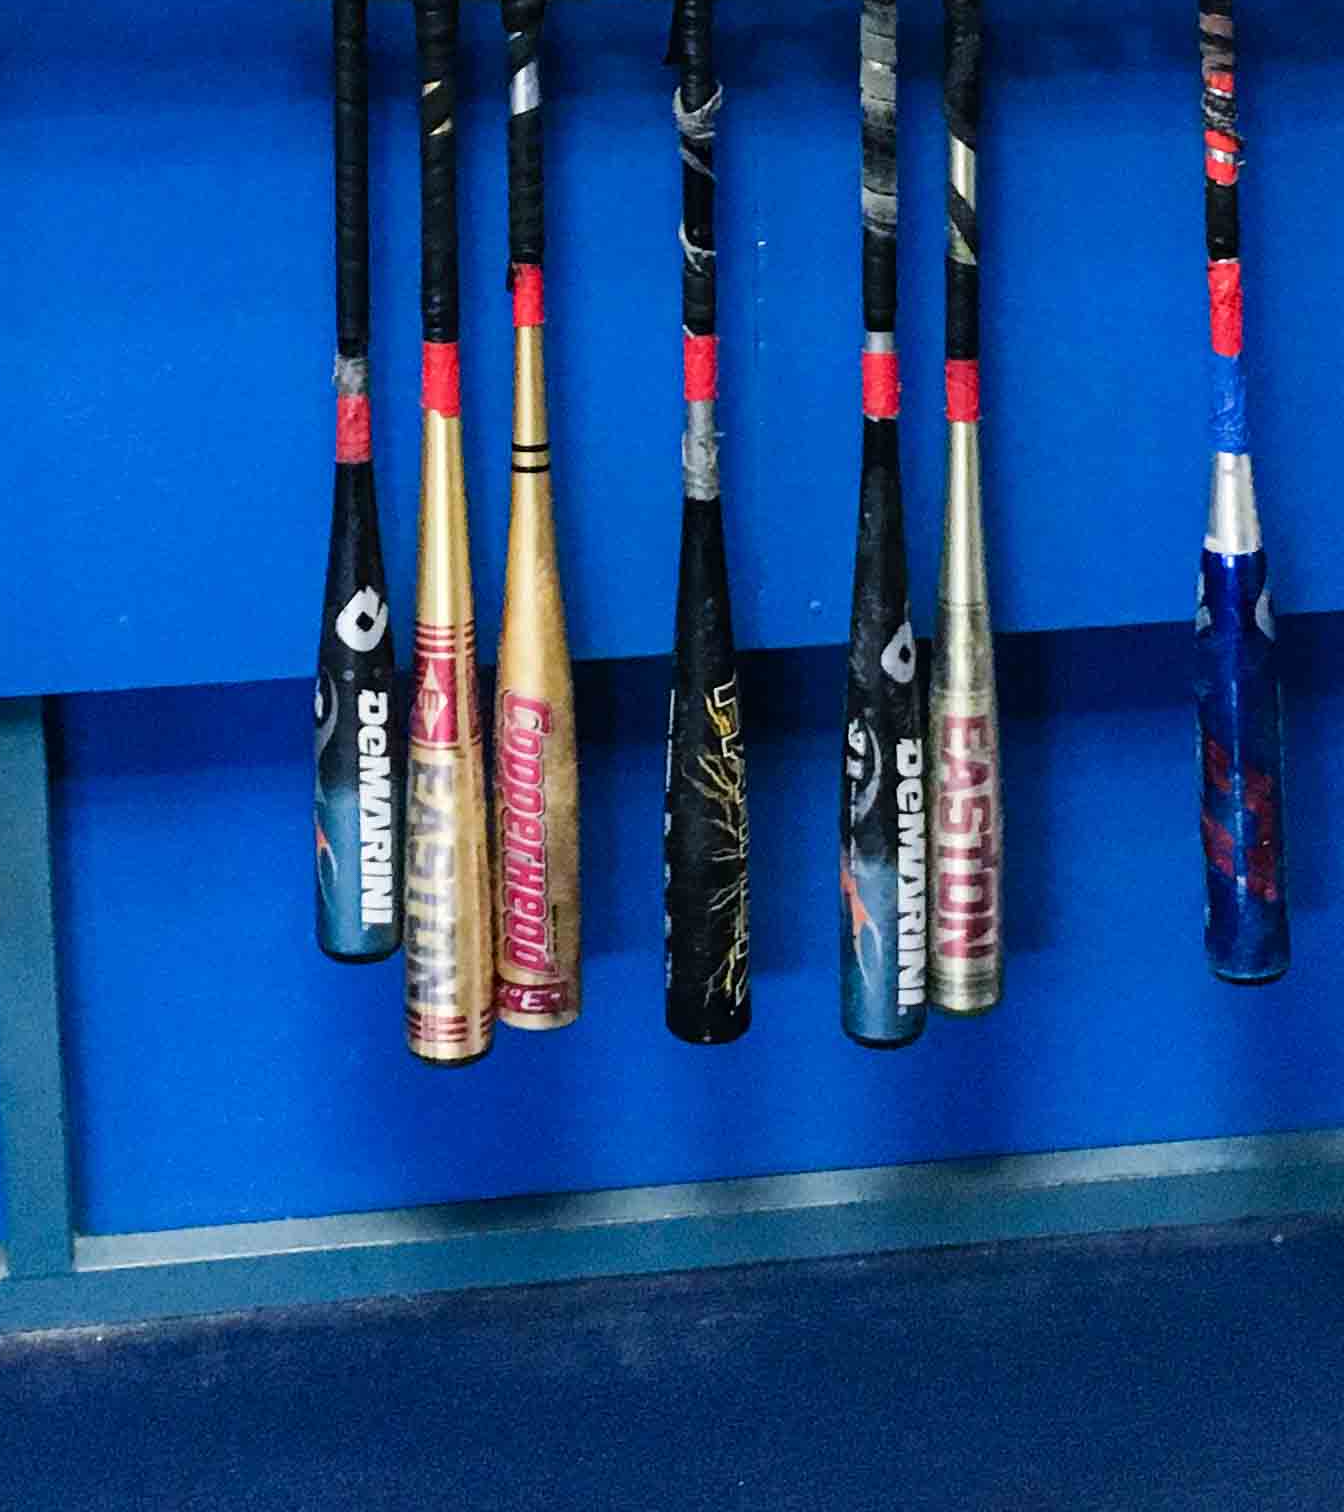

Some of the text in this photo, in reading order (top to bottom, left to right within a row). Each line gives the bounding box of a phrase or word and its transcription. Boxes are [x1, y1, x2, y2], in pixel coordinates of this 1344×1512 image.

[358, 689, 394, 925] DeMARINI
[897, 737, 925, 1006] DeMARINI
[940, 714, 995, 959] EASTON
